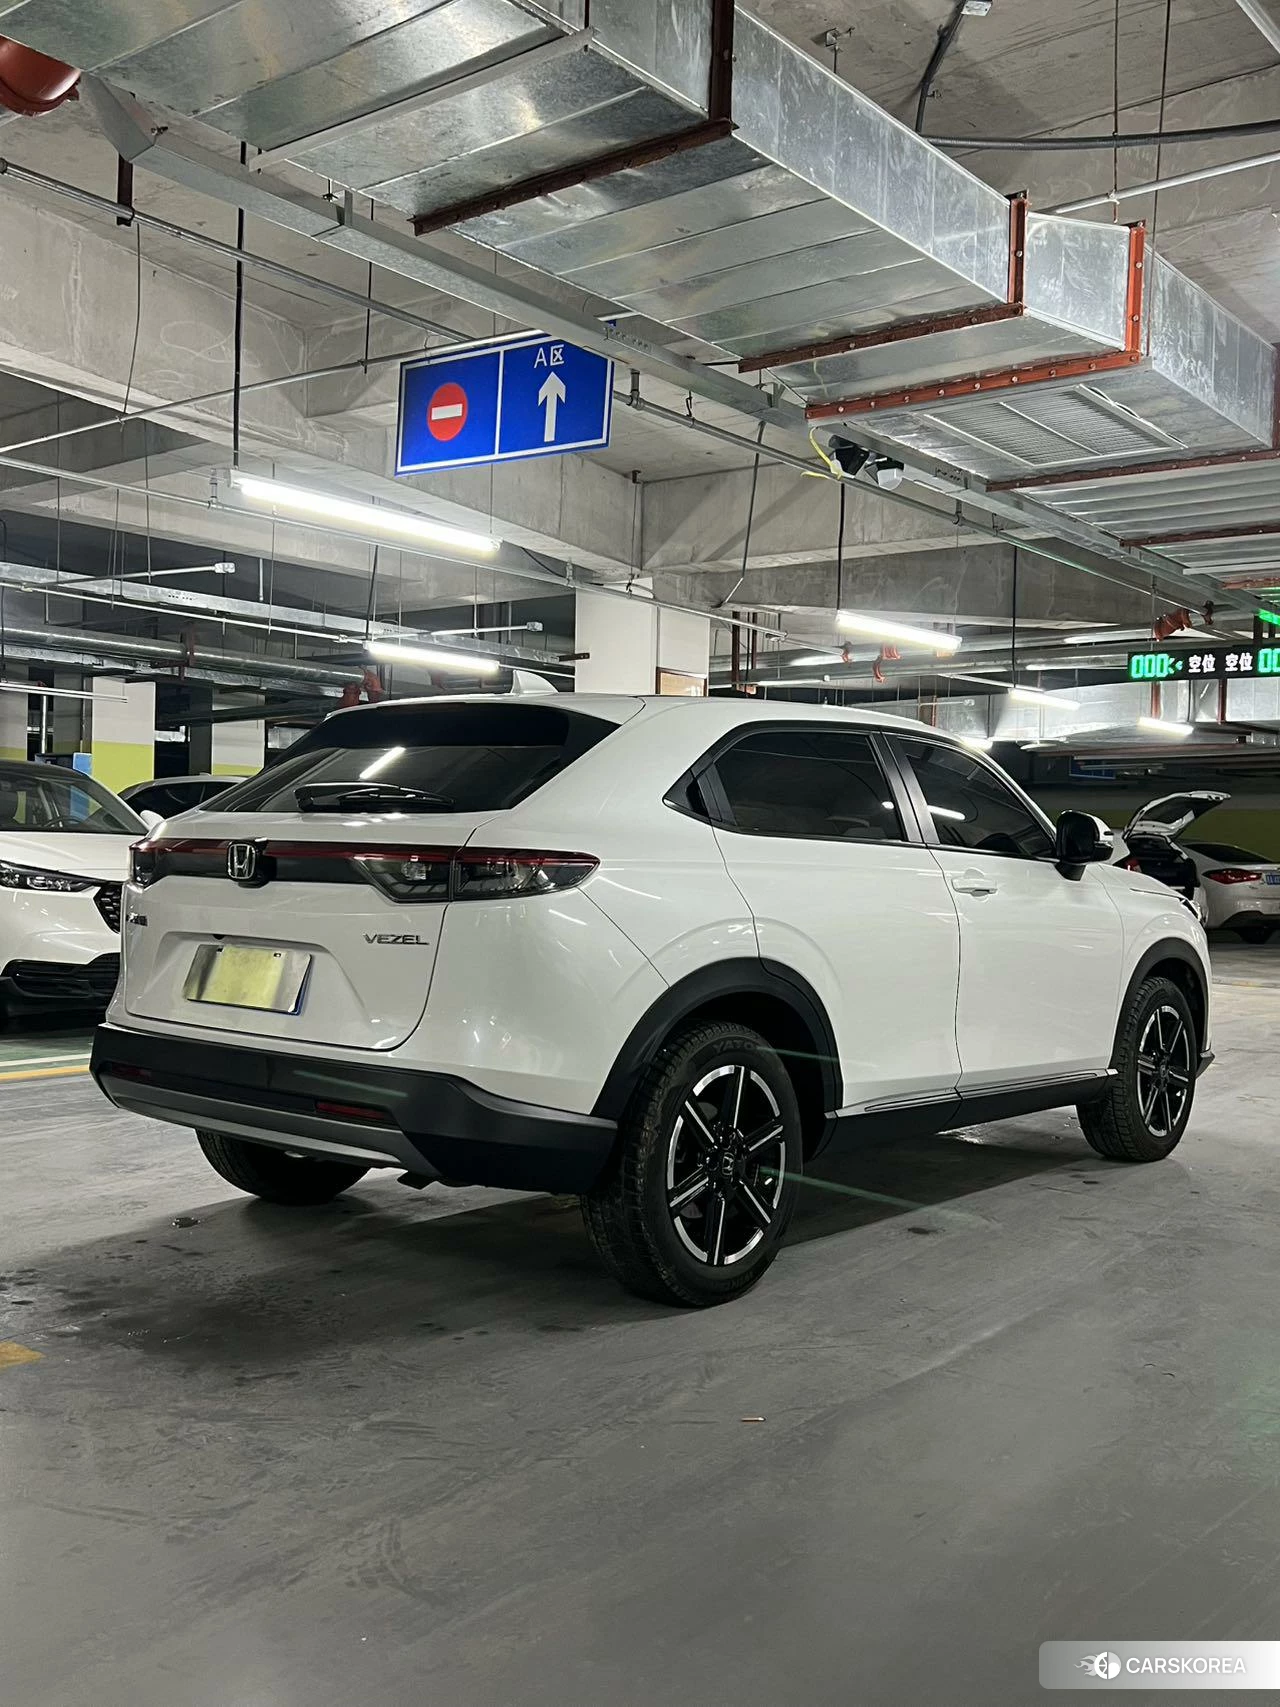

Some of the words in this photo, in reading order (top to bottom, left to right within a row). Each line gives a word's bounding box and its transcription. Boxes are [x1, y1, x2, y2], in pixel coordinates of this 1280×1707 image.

[533, 344, 565, 369] A区
[1188, 653, 1216, 673] 空位
[1225, 652, 1253, 671] 空位
[362, 933, 430, 945] VEZEL
